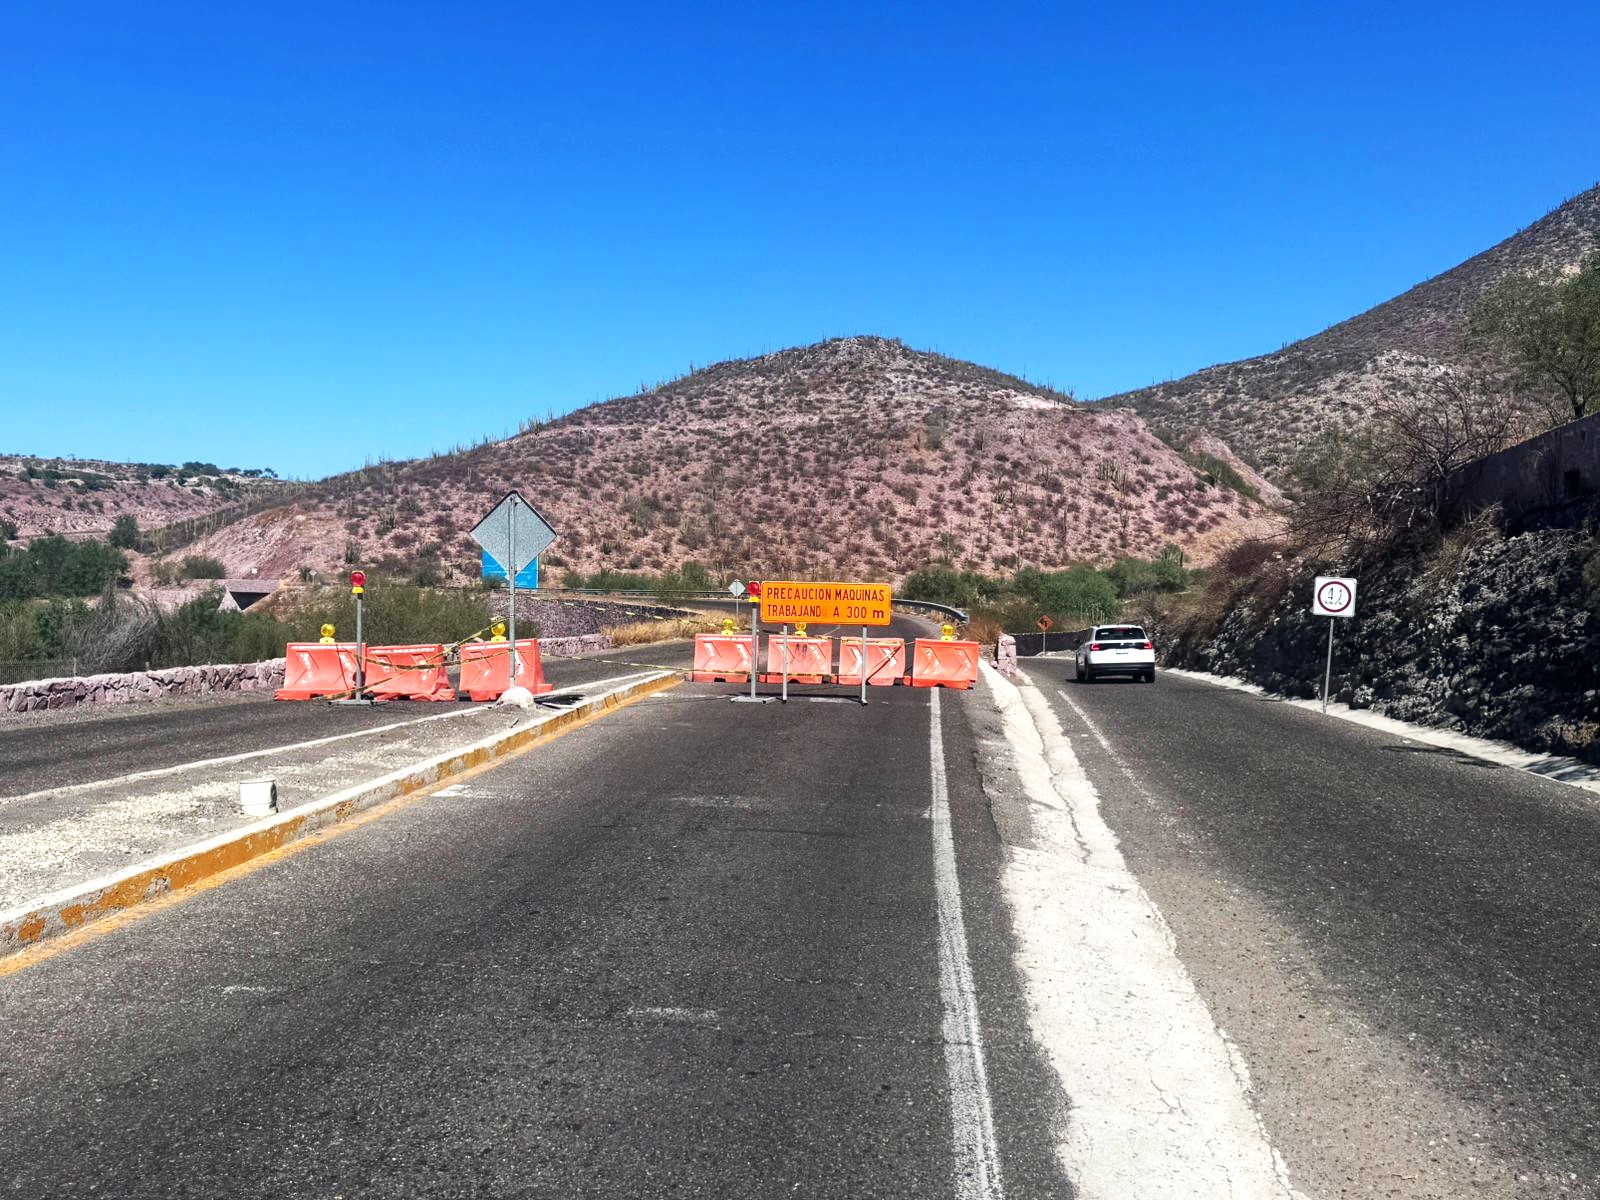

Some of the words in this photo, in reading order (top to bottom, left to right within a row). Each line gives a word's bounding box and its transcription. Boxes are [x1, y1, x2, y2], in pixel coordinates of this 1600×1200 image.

[767, 587, 831, 600] PRECAUCION
[835, 589, 885, 601] MAQUINAS
[833, 607, 840, 617] A
[847, 607, 867, 618] 300
[872, 610, 884, 619] m
